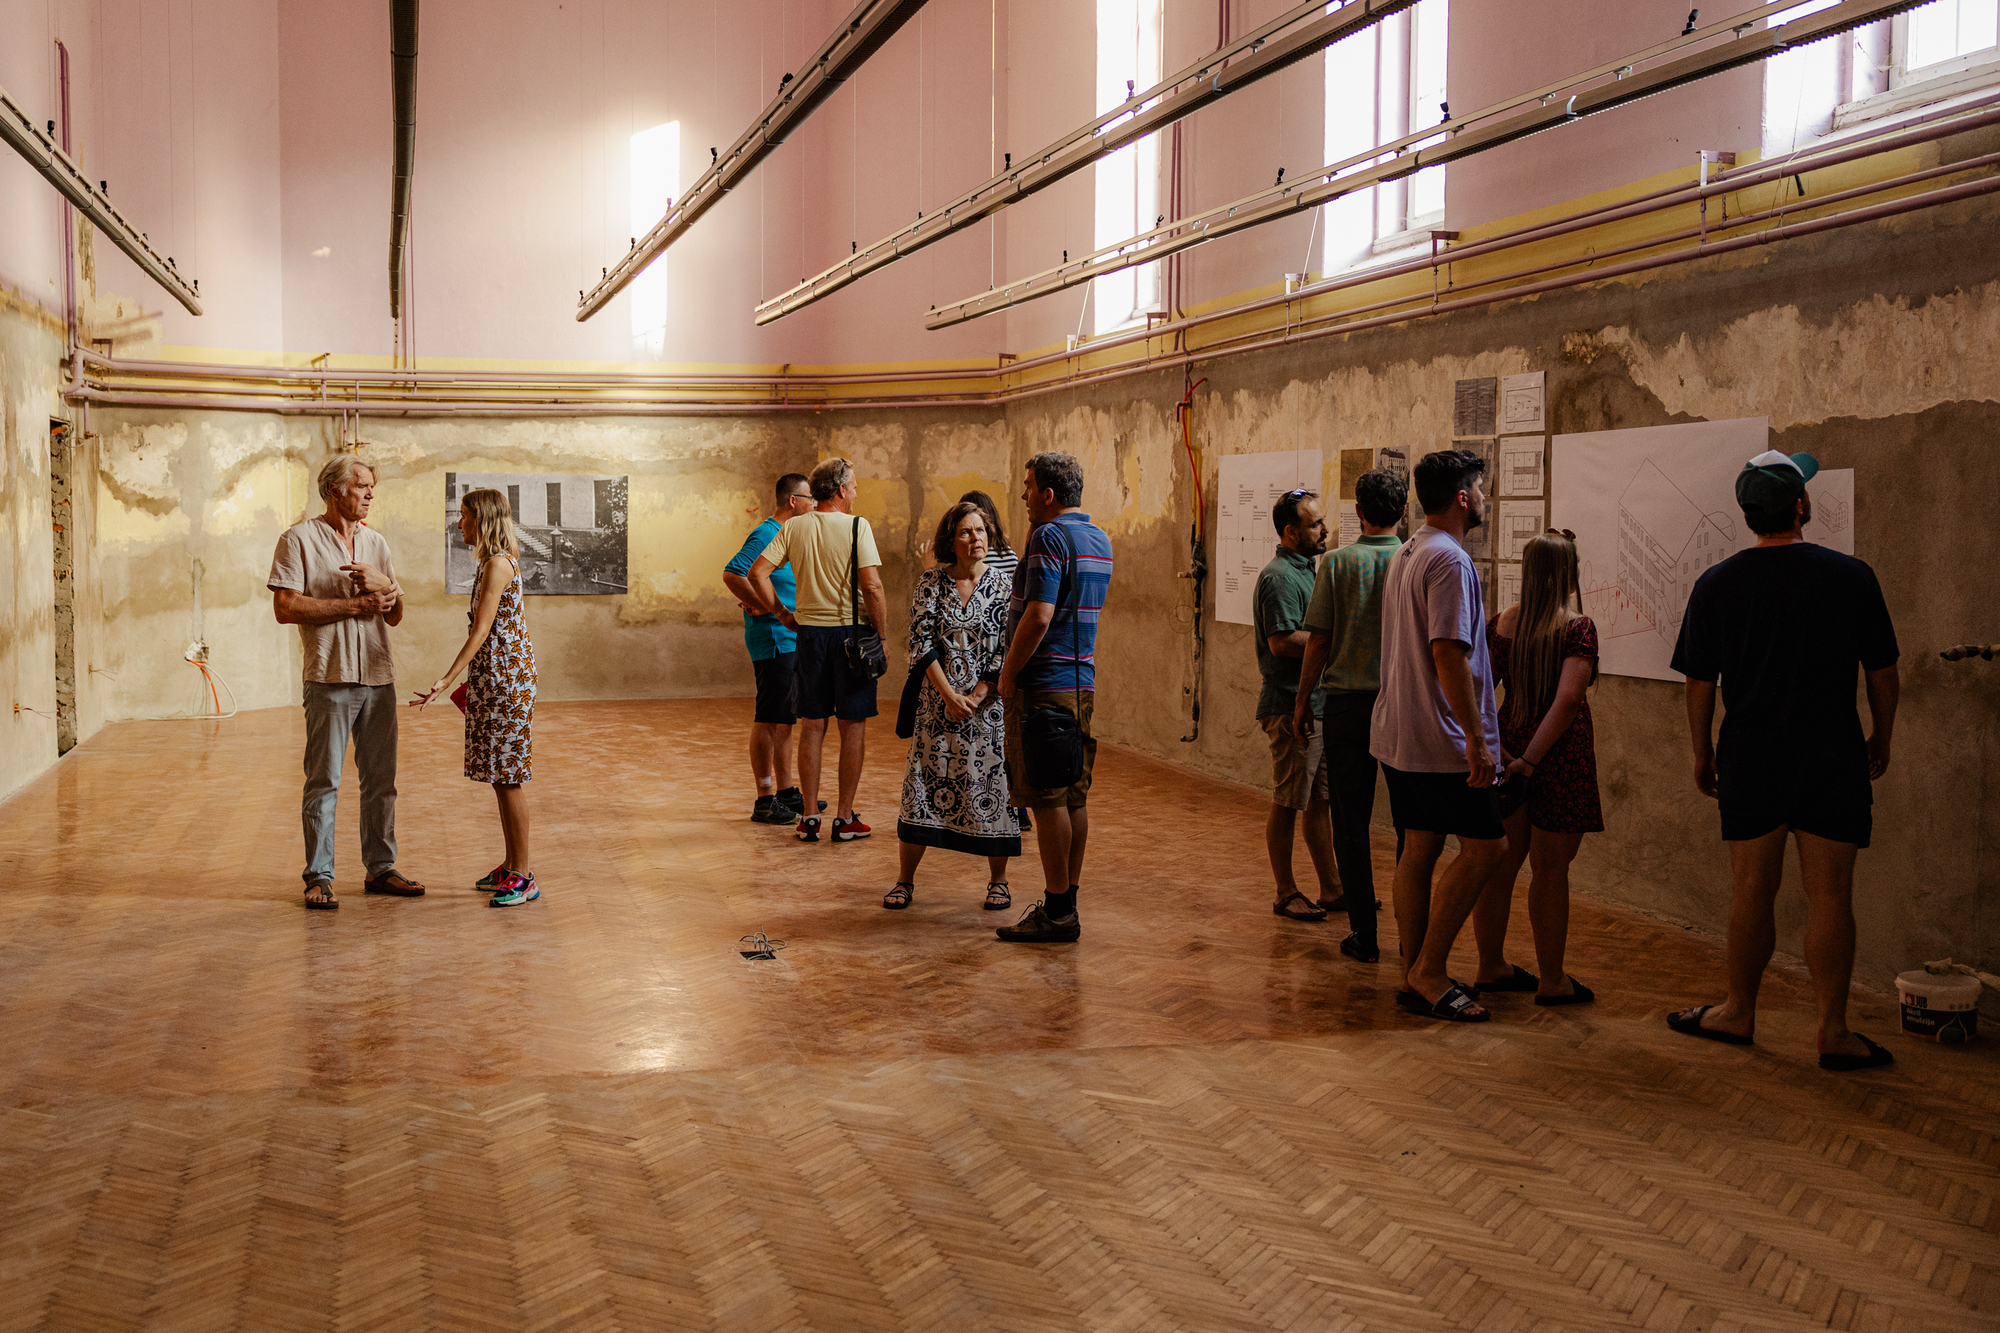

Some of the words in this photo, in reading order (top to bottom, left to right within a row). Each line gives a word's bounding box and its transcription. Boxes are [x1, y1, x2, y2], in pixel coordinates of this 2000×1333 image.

[1915, 996, 1927, 1008] JUB
[1906, 1007, 1921, 1016] Akril
[1906, 1016, 1935, 1026] emulzija
